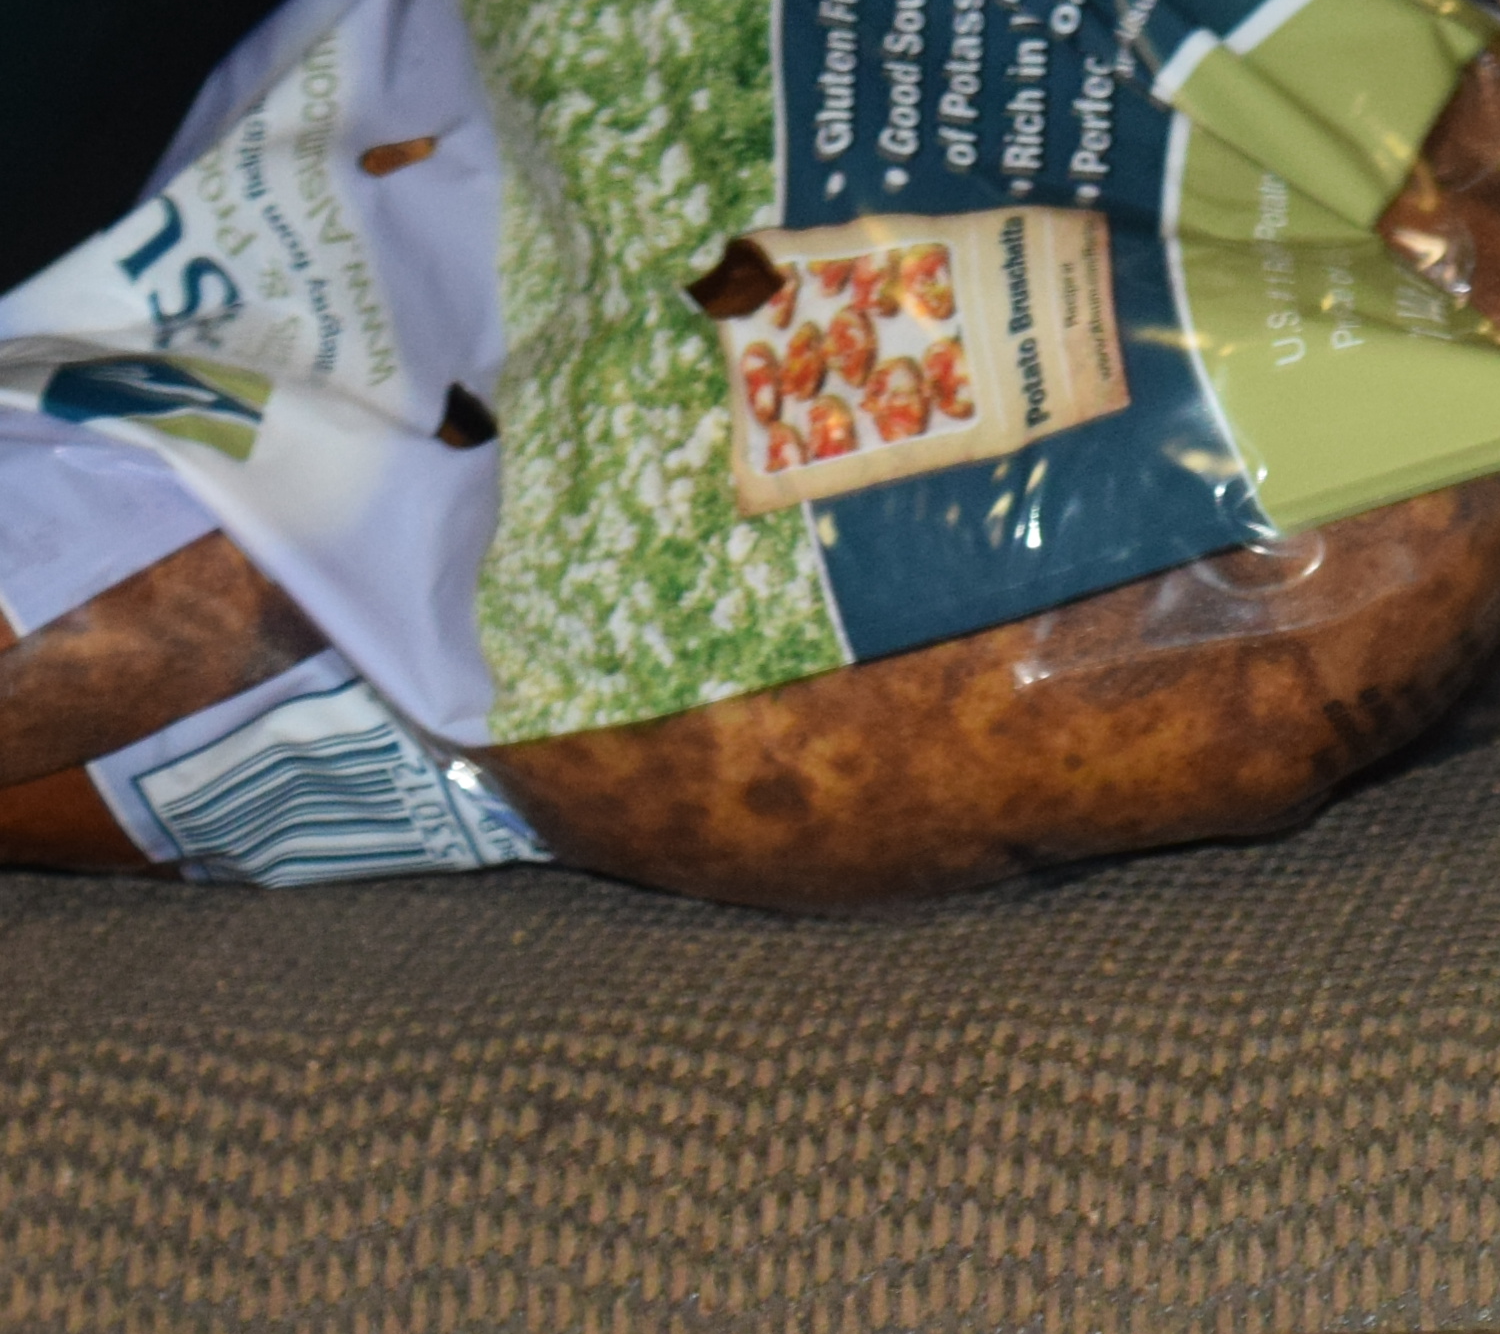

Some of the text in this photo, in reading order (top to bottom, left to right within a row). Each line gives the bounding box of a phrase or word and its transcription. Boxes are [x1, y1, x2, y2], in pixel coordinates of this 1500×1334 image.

[815, 27, 858, 158] Gluten
[1007, 38, 1049, 78] in
[879, 62, 922, 156] Good
[939, 125, 978, 168] of
[1003, 87, 1047, 169] Rich
[1071, 57, 1116, 174] Perfec
[1016, 336, 1051, 428] Potato
